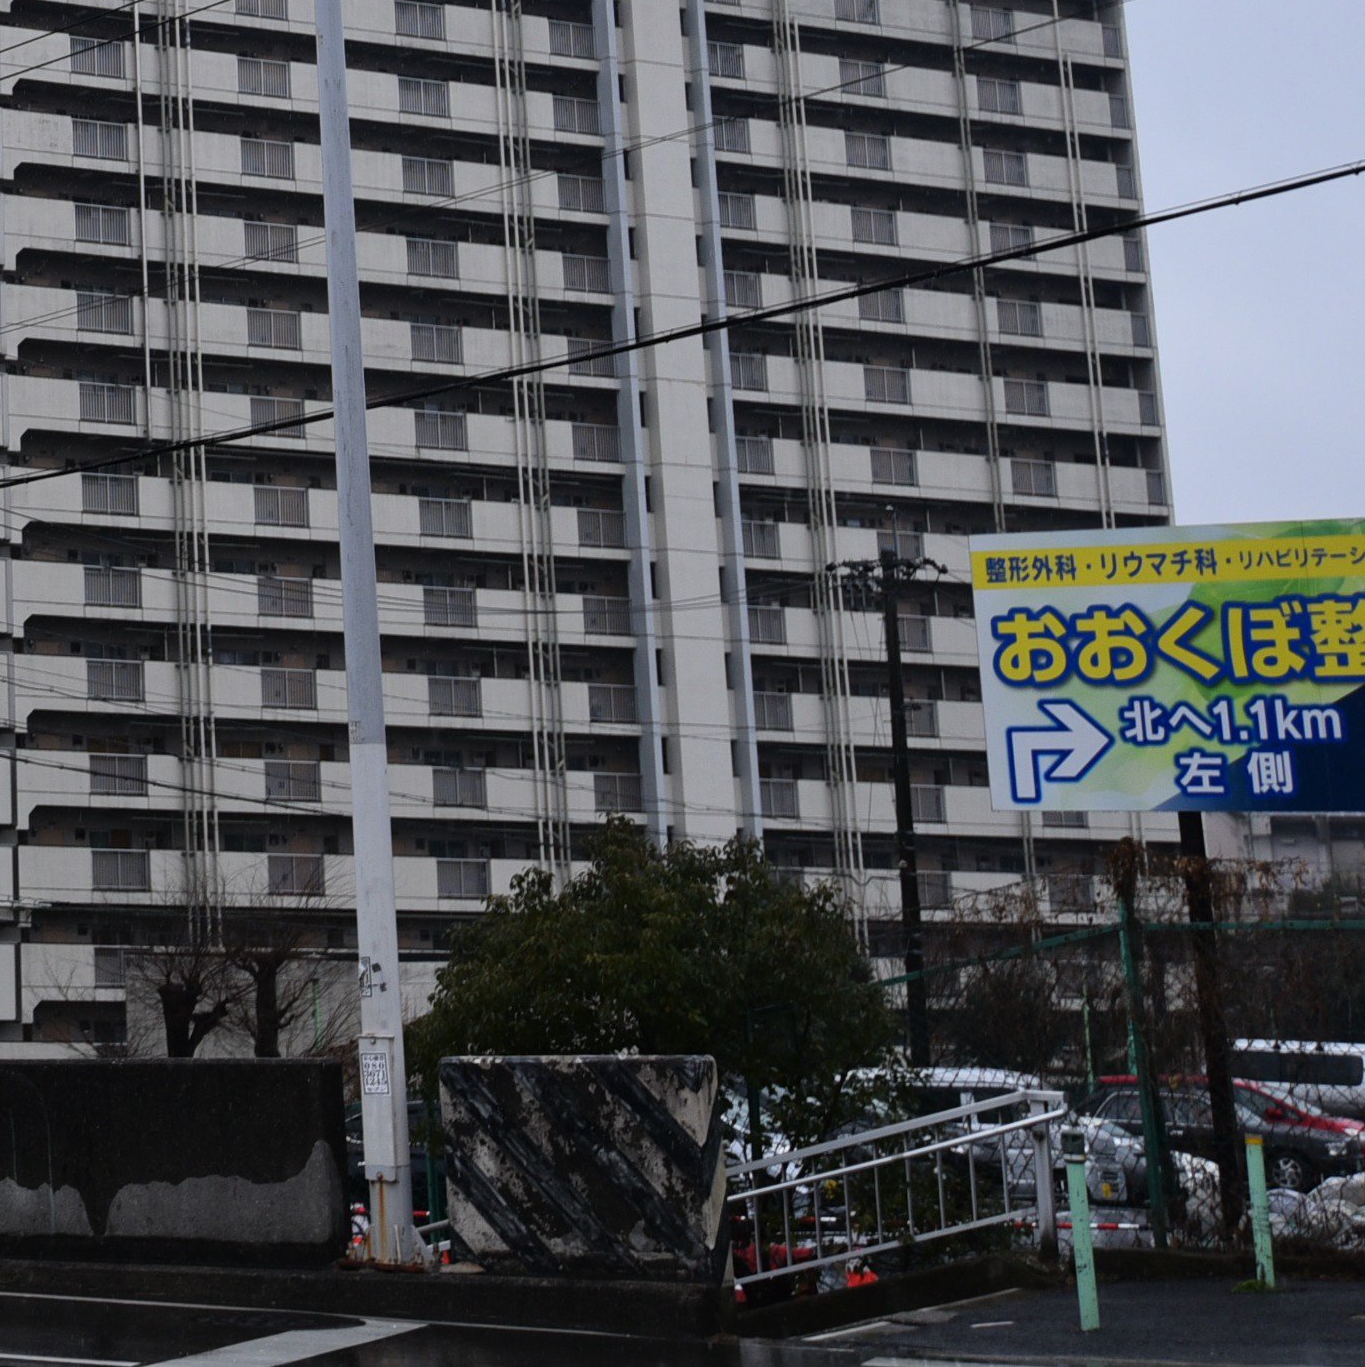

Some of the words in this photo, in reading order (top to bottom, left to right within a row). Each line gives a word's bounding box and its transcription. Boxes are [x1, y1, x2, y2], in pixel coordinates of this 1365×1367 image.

[994, 597, 1365, 684] おおくぼ整
[1123, 698, 1342, 742] 北へ1.1km
